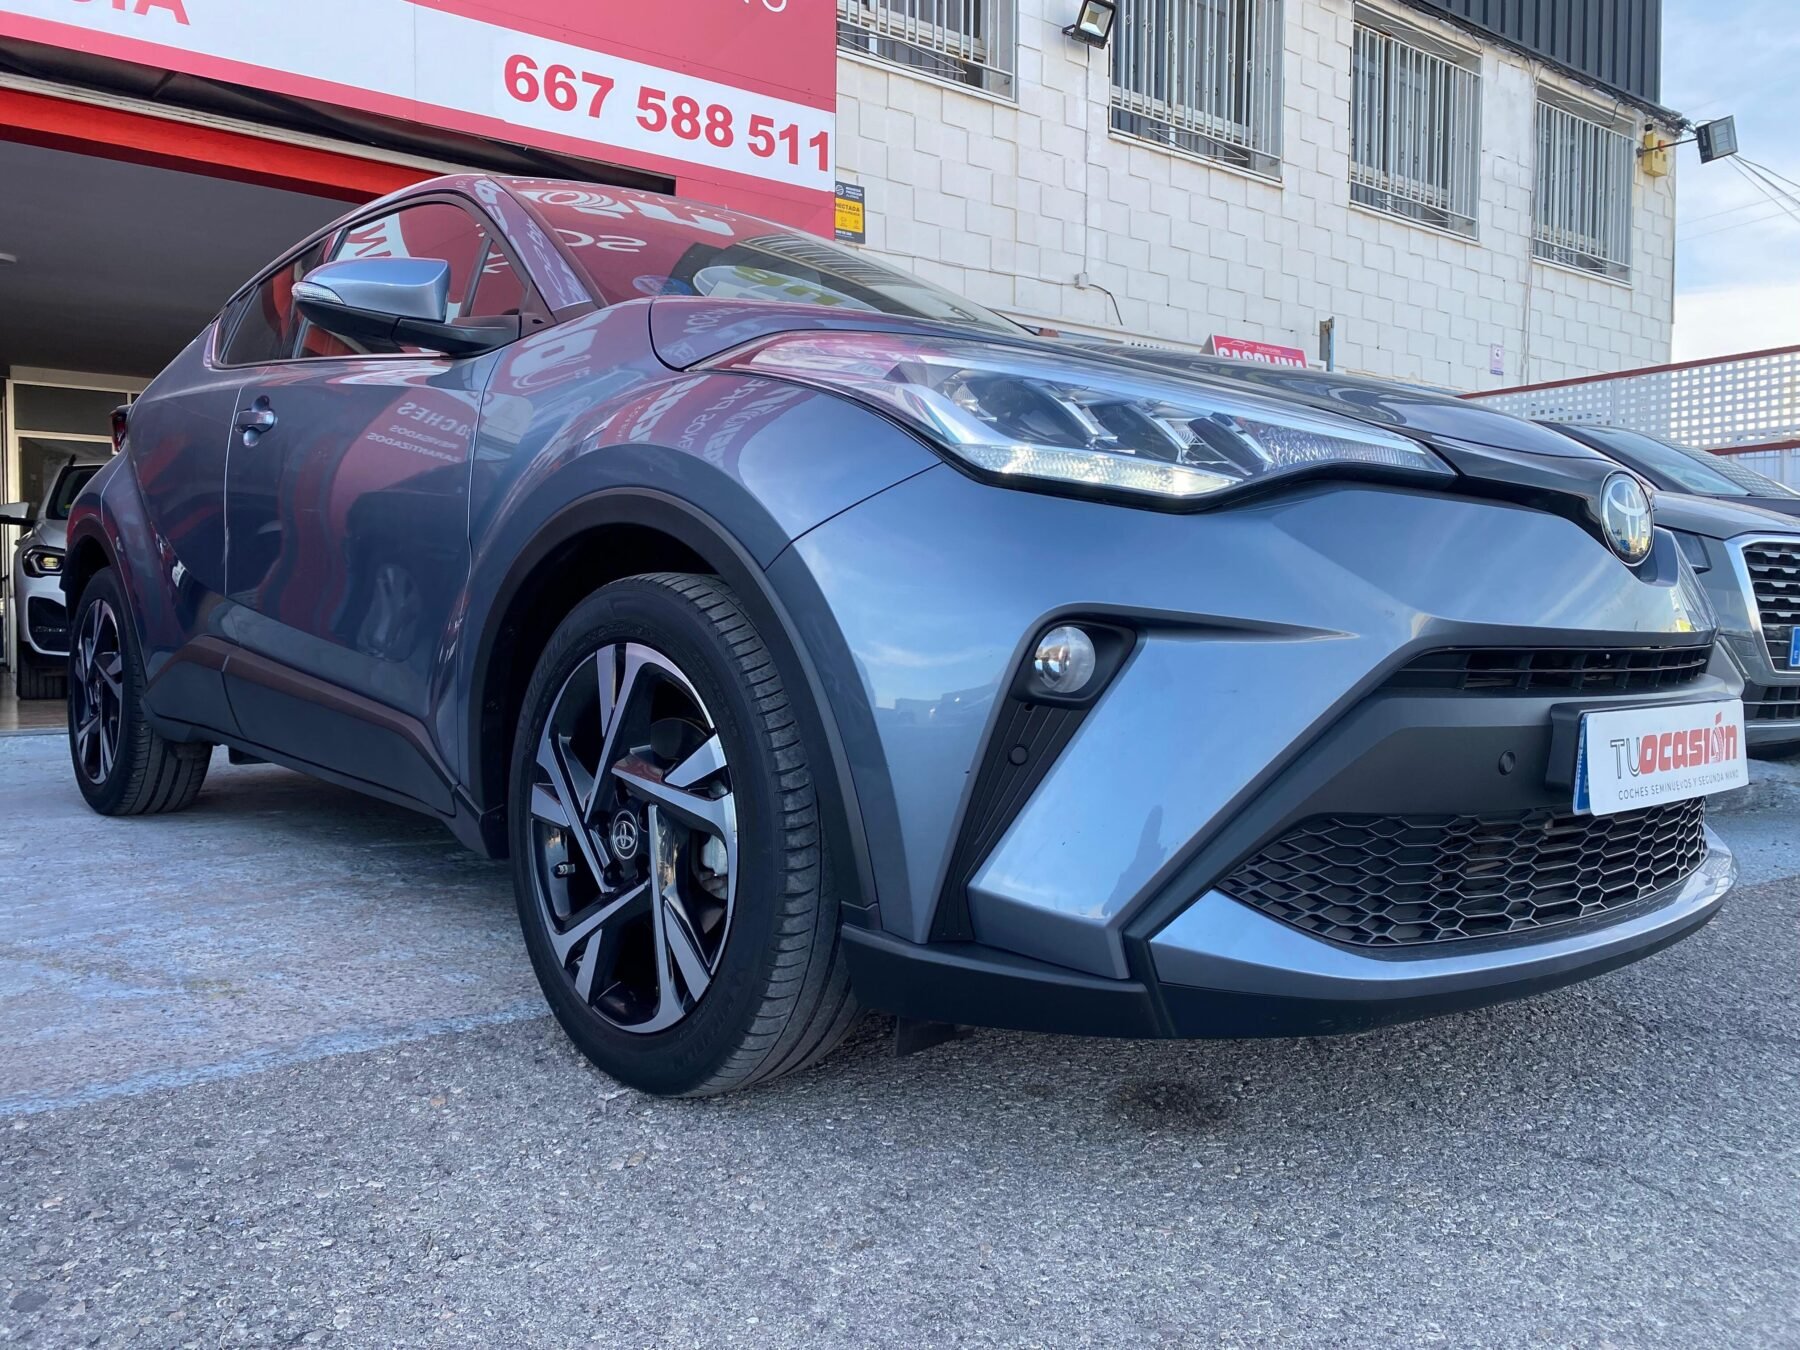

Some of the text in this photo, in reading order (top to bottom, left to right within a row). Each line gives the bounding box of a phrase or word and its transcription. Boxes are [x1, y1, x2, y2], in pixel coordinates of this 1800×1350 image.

[504, 54, 830, 172] 667 588 511
[1618, 785, 1649, 801] COCHES
[1651, 778, 1692, 796] SEMINUEVOS
[1699, 772, 1724, 787] SEGUNDA
